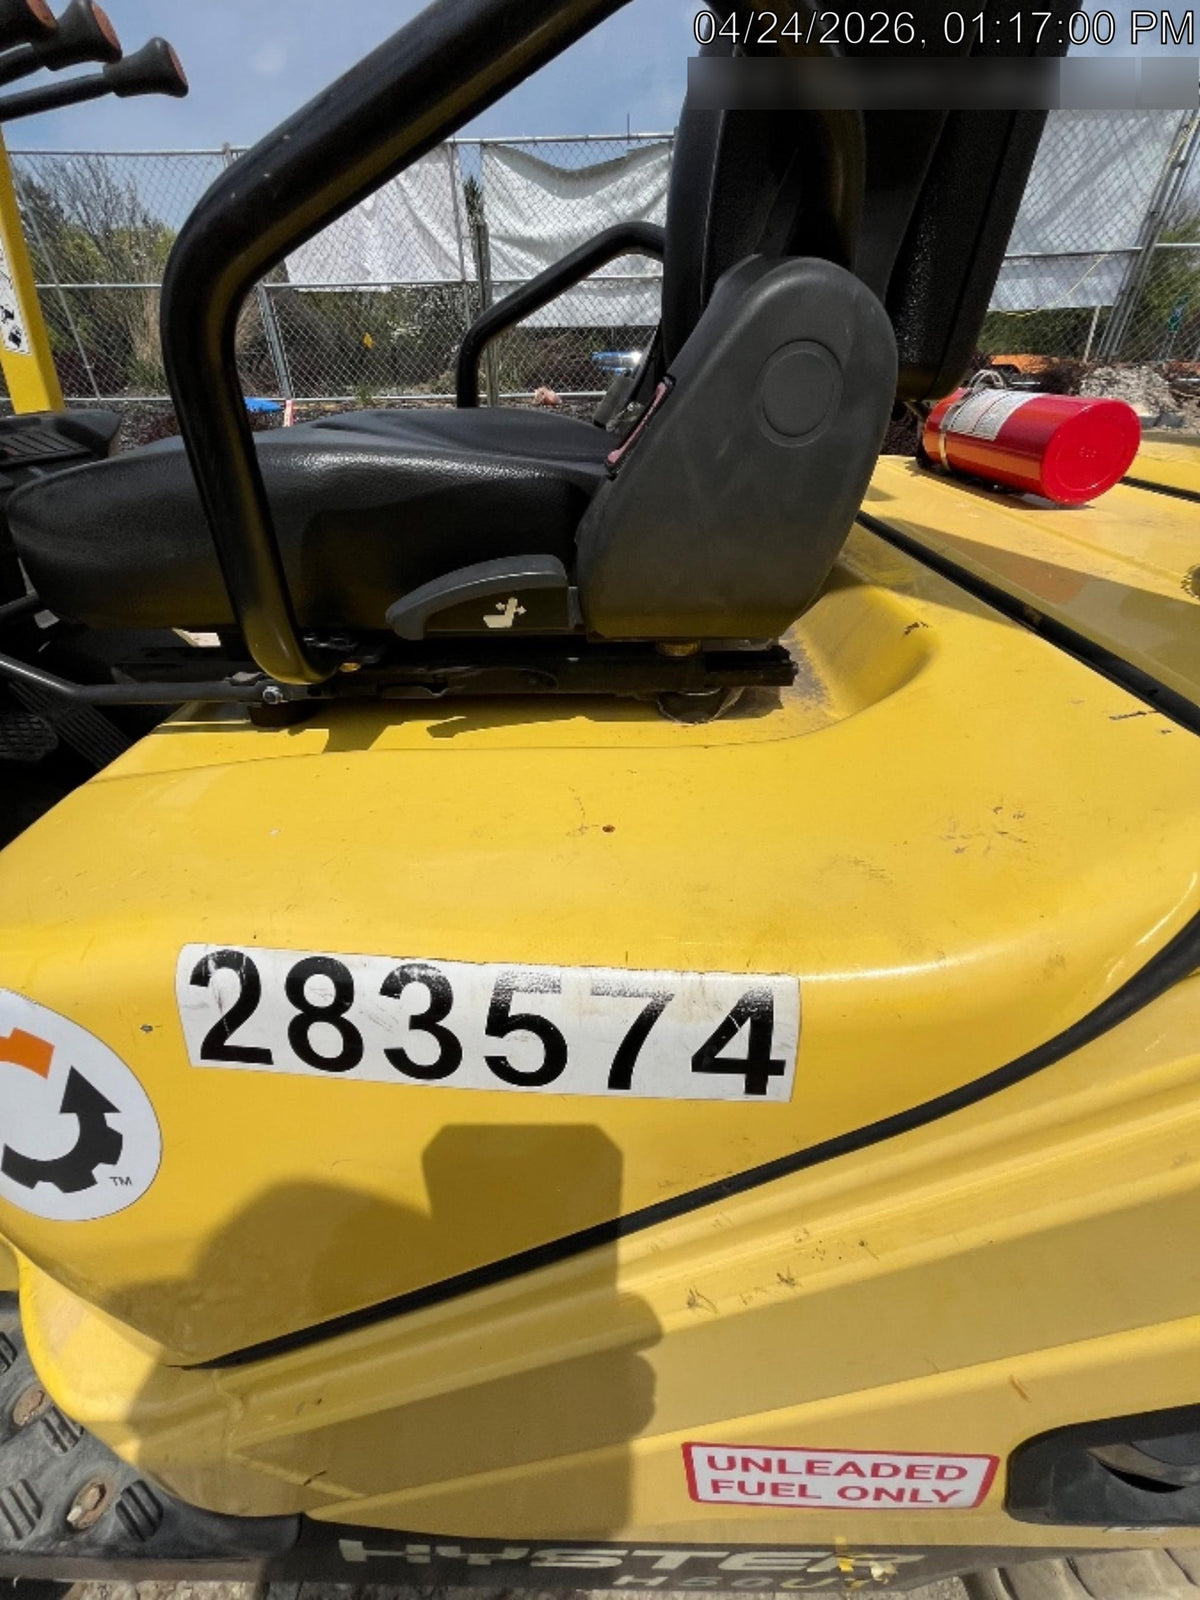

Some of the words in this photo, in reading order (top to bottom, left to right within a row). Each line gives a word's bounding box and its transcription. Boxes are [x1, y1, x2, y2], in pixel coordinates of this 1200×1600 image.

[189, 948, 787, 1096] 283574
[706, 1455, 969, 1480] UNLEADED
[710, 1478, 822, 1499] FUEL
[836, 1485, 963, 1503] ONLY
[338, 1539, 926, 1573] HYSTER
